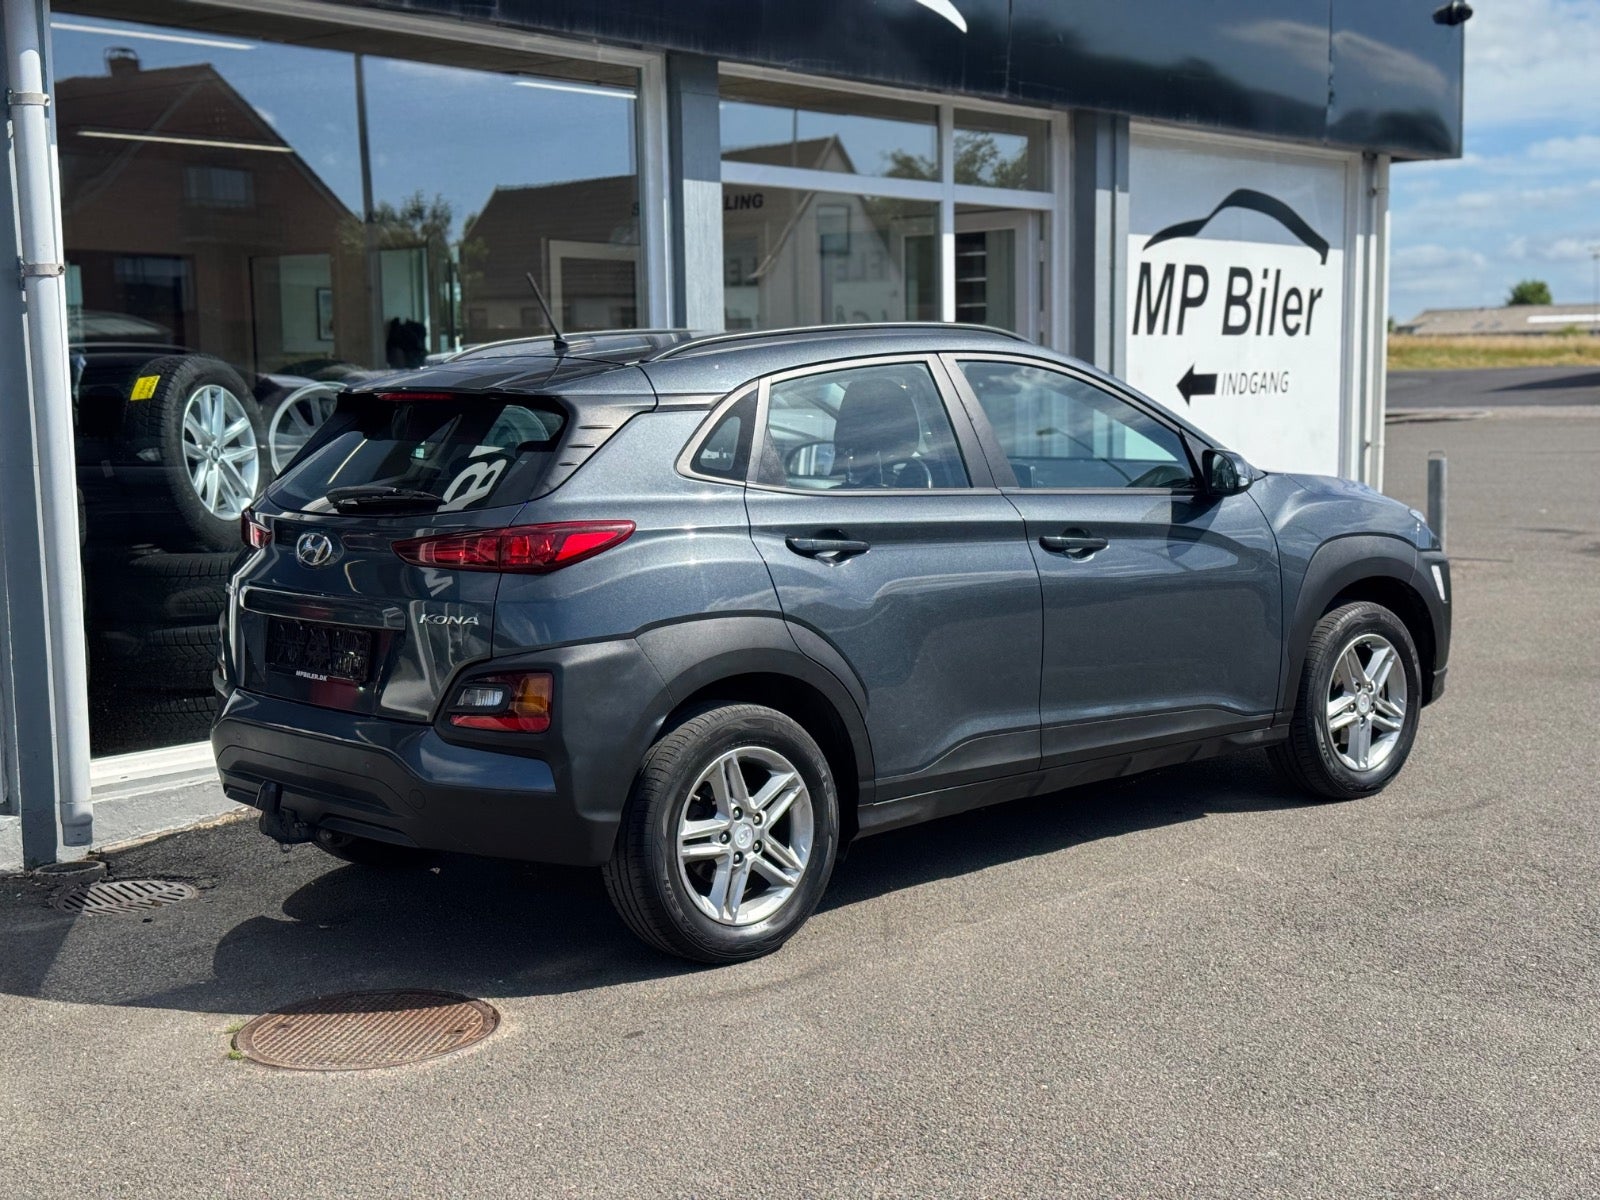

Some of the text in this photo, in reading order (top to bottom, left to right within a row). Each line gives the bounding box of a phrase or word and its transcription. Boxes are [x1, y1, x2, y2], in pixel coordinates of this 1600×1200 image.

[1131, 262, 1324, 337] MP Biler
[1221, 371, 1290, 395] INDGANG
[419, 613, 479, 625] KONA
